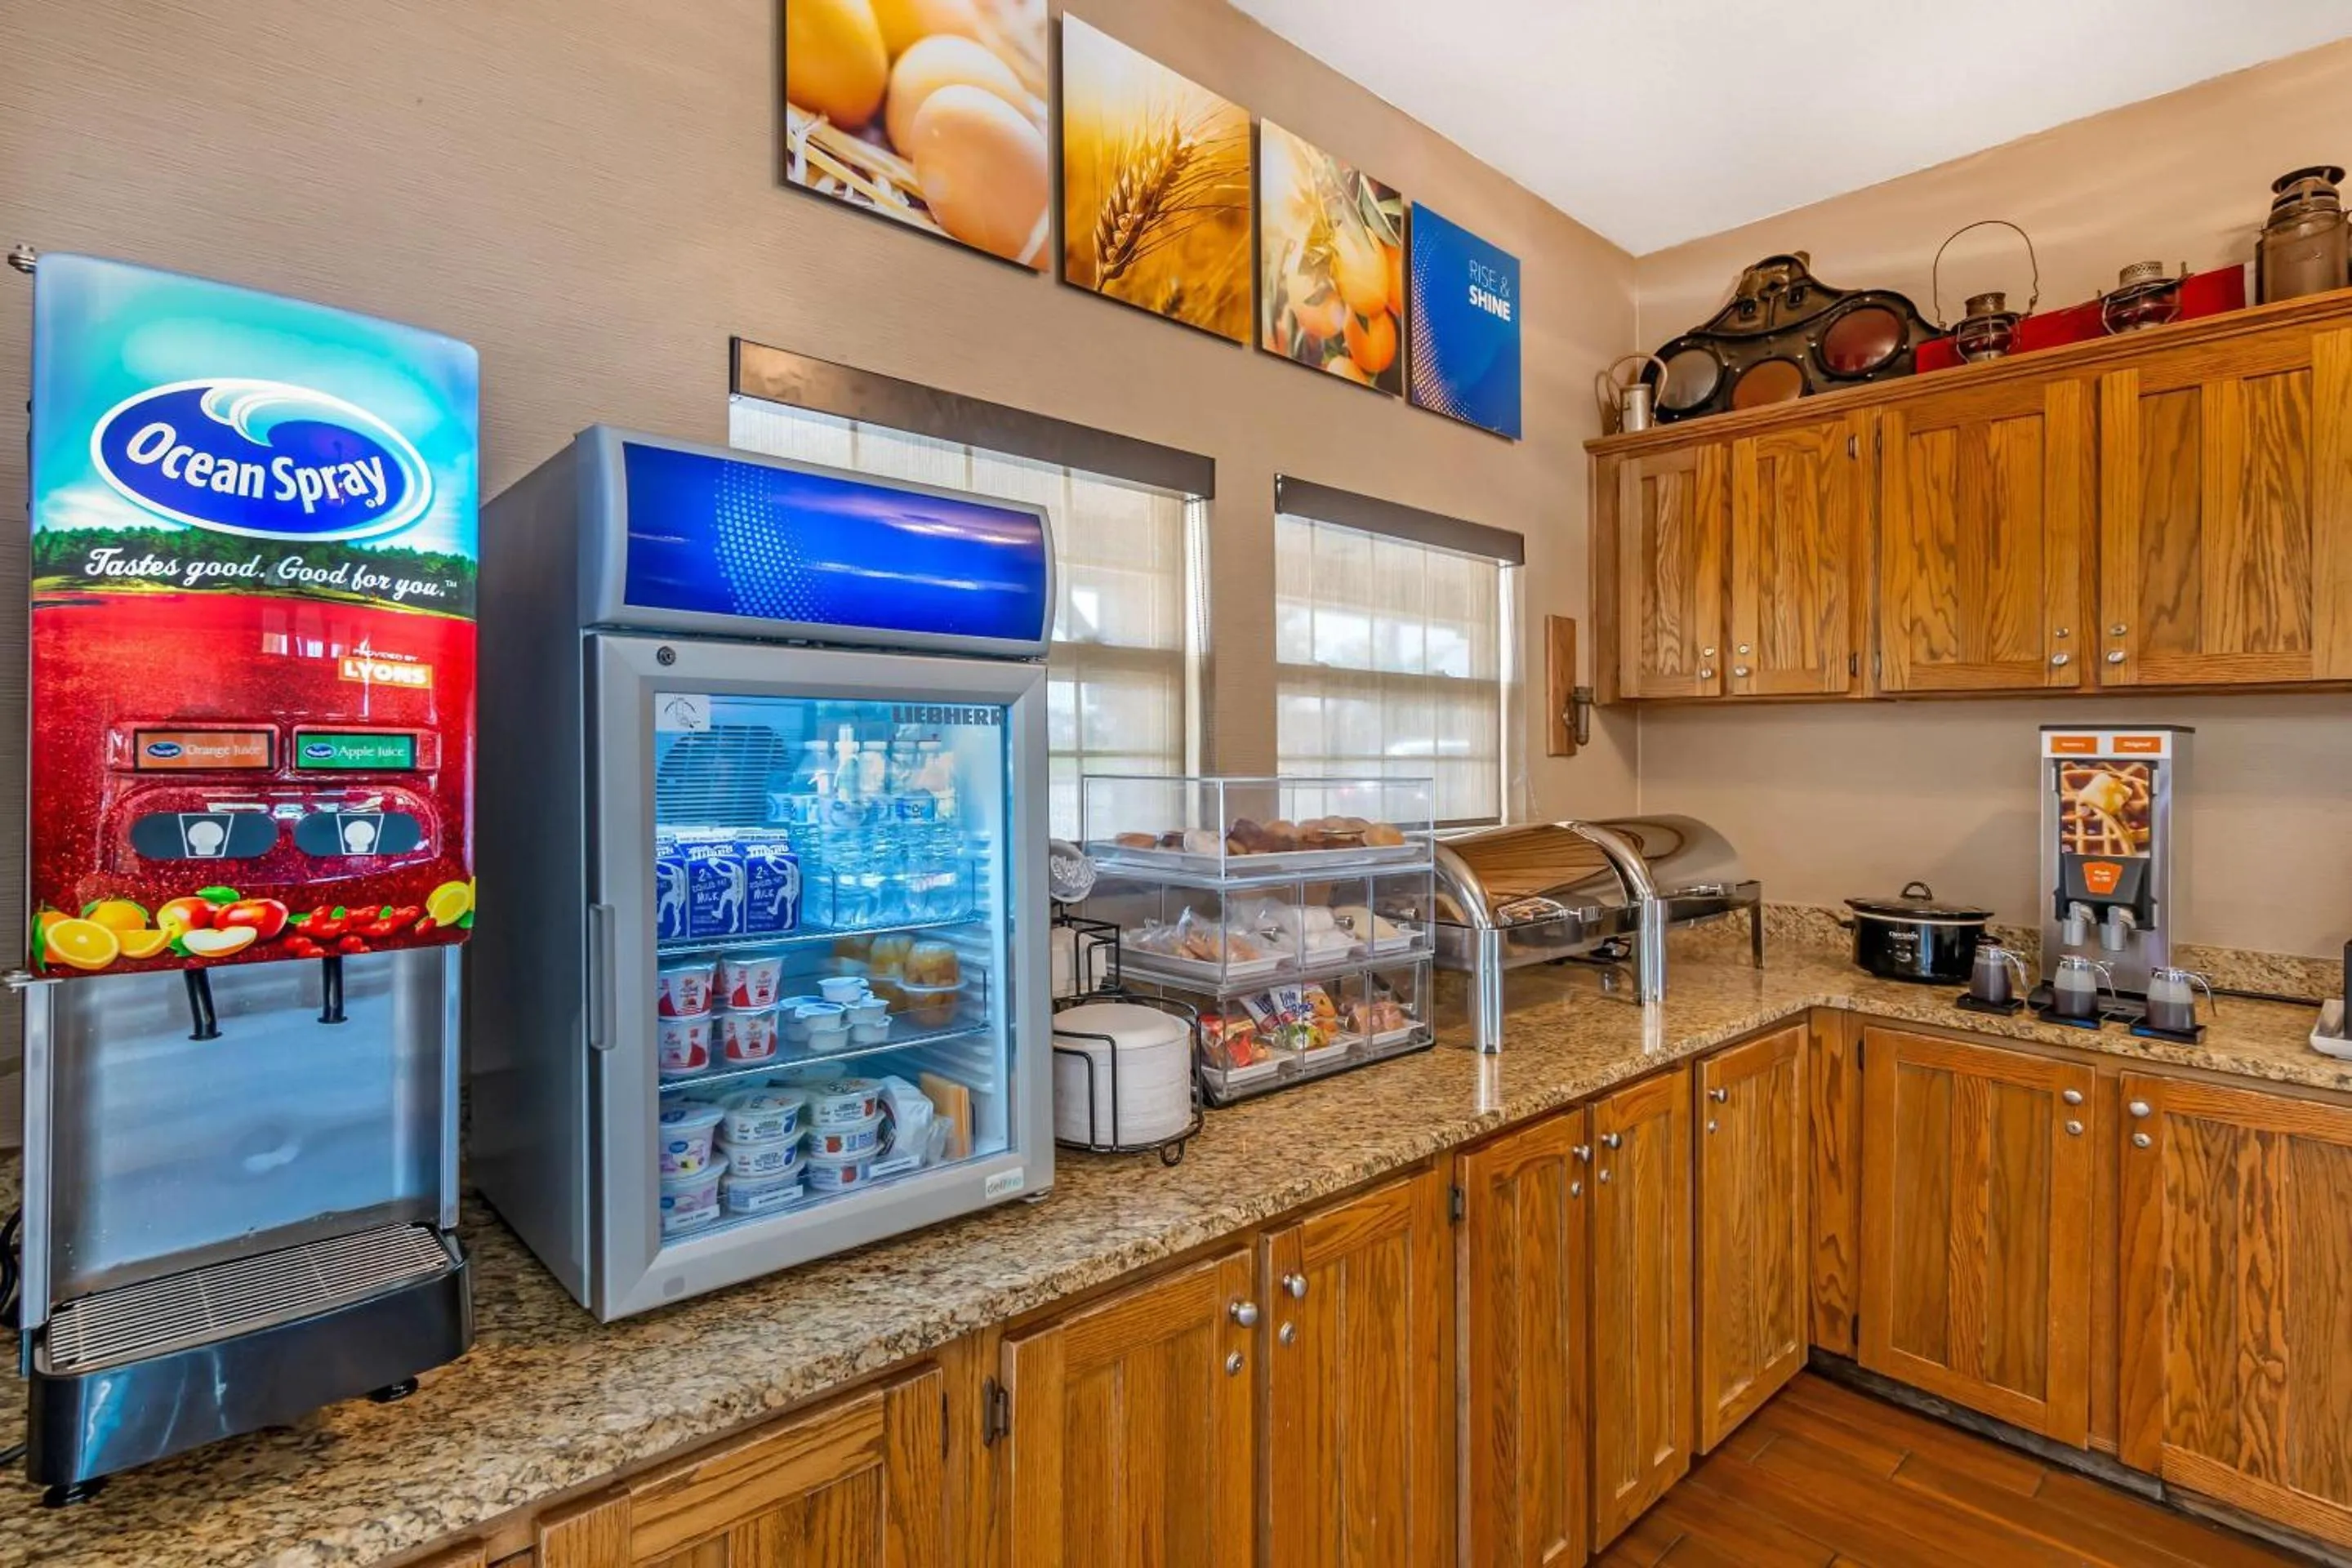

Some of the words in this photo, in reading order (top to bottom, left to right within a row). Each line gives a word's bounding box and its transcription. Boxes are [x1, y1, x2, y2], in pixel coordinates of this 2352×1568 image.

[1469, 260, 1496, 292] RISE
[1500, 277, 1510, 298] &
[1469, 285, 1511, 322] SHINE
[127, 422, 265, 499] Ocean
[271, 456, 387, 514] Spray
[85, 546, 180, 576] Tastes
[182, 555, 265, 586] good.
[278, 556, 350, 584] Good
[351, 564, 392, 590] for
[344, 660, 427, 684] LYONS
[893, 705, 1001, 725] LIEBHERR
[186, 744, 229, 758] Orange
[338, 746, 375, 760] Apple
[378, 746, 405, 756] Juice
